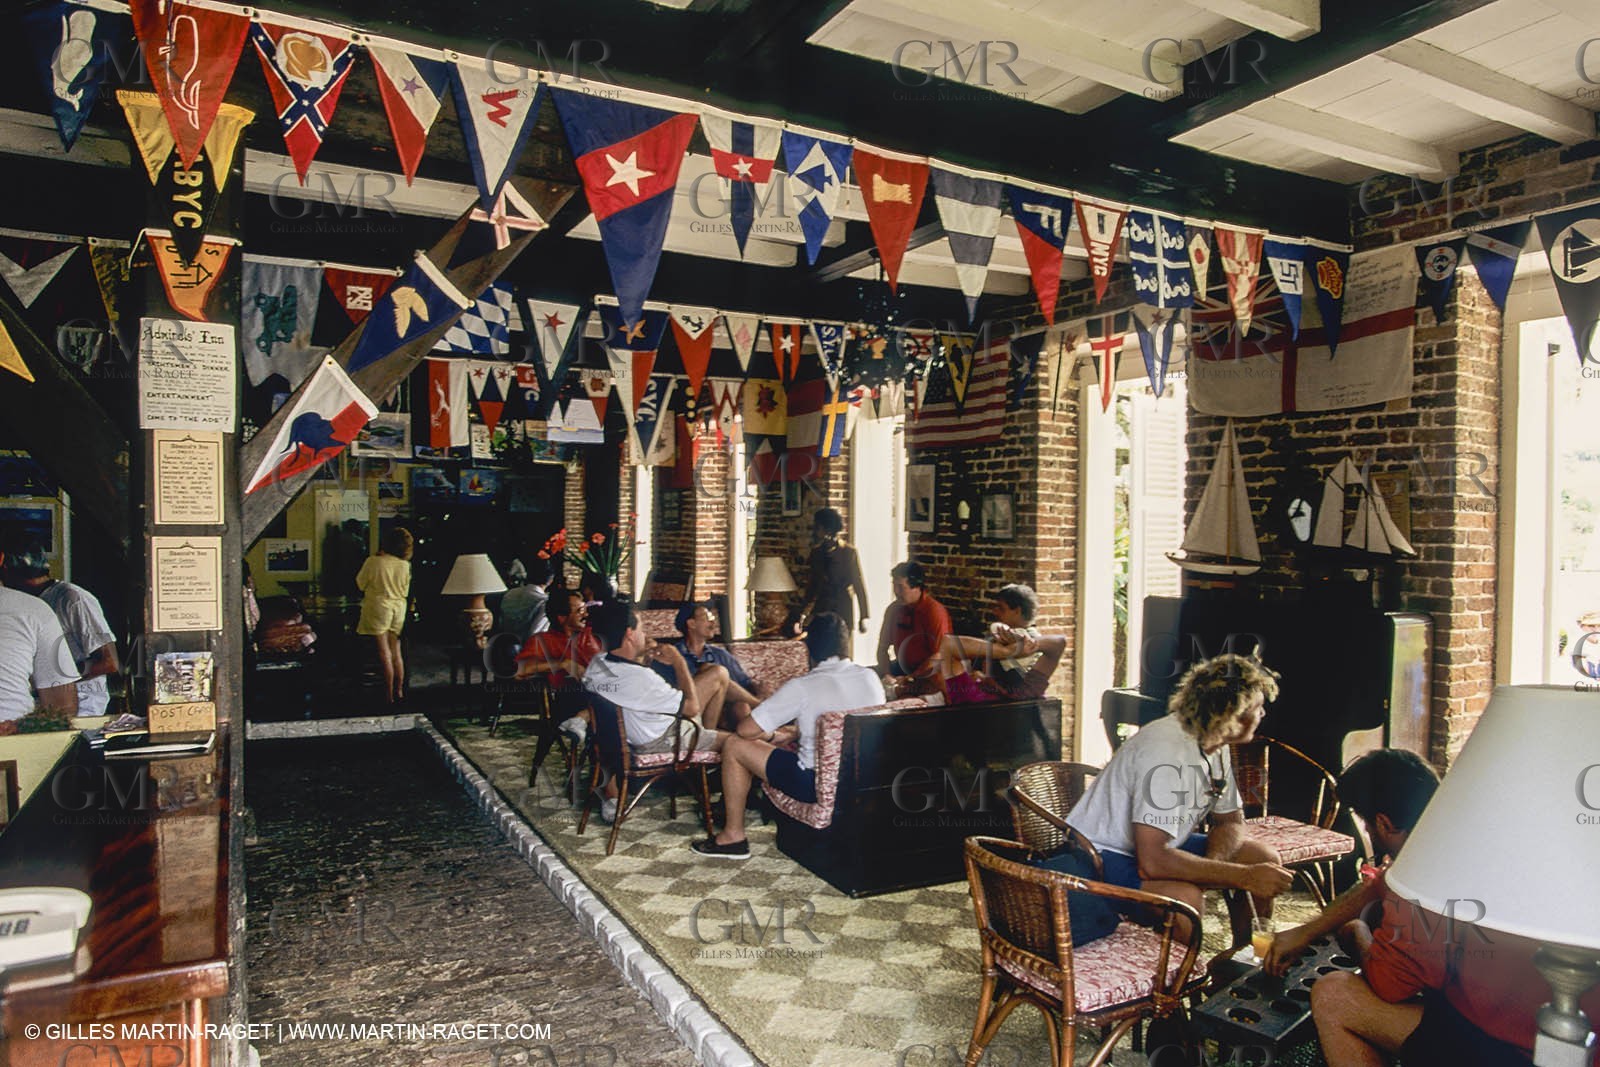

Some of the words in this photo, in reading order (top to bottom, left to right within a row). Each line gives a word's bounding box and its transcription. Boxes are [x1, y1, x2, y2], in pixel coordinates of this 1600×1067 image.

[1089, 242, 1110, 277] MYC
[199, 330, 225, 345] Inn
[151, 705, 183, 721] POST
